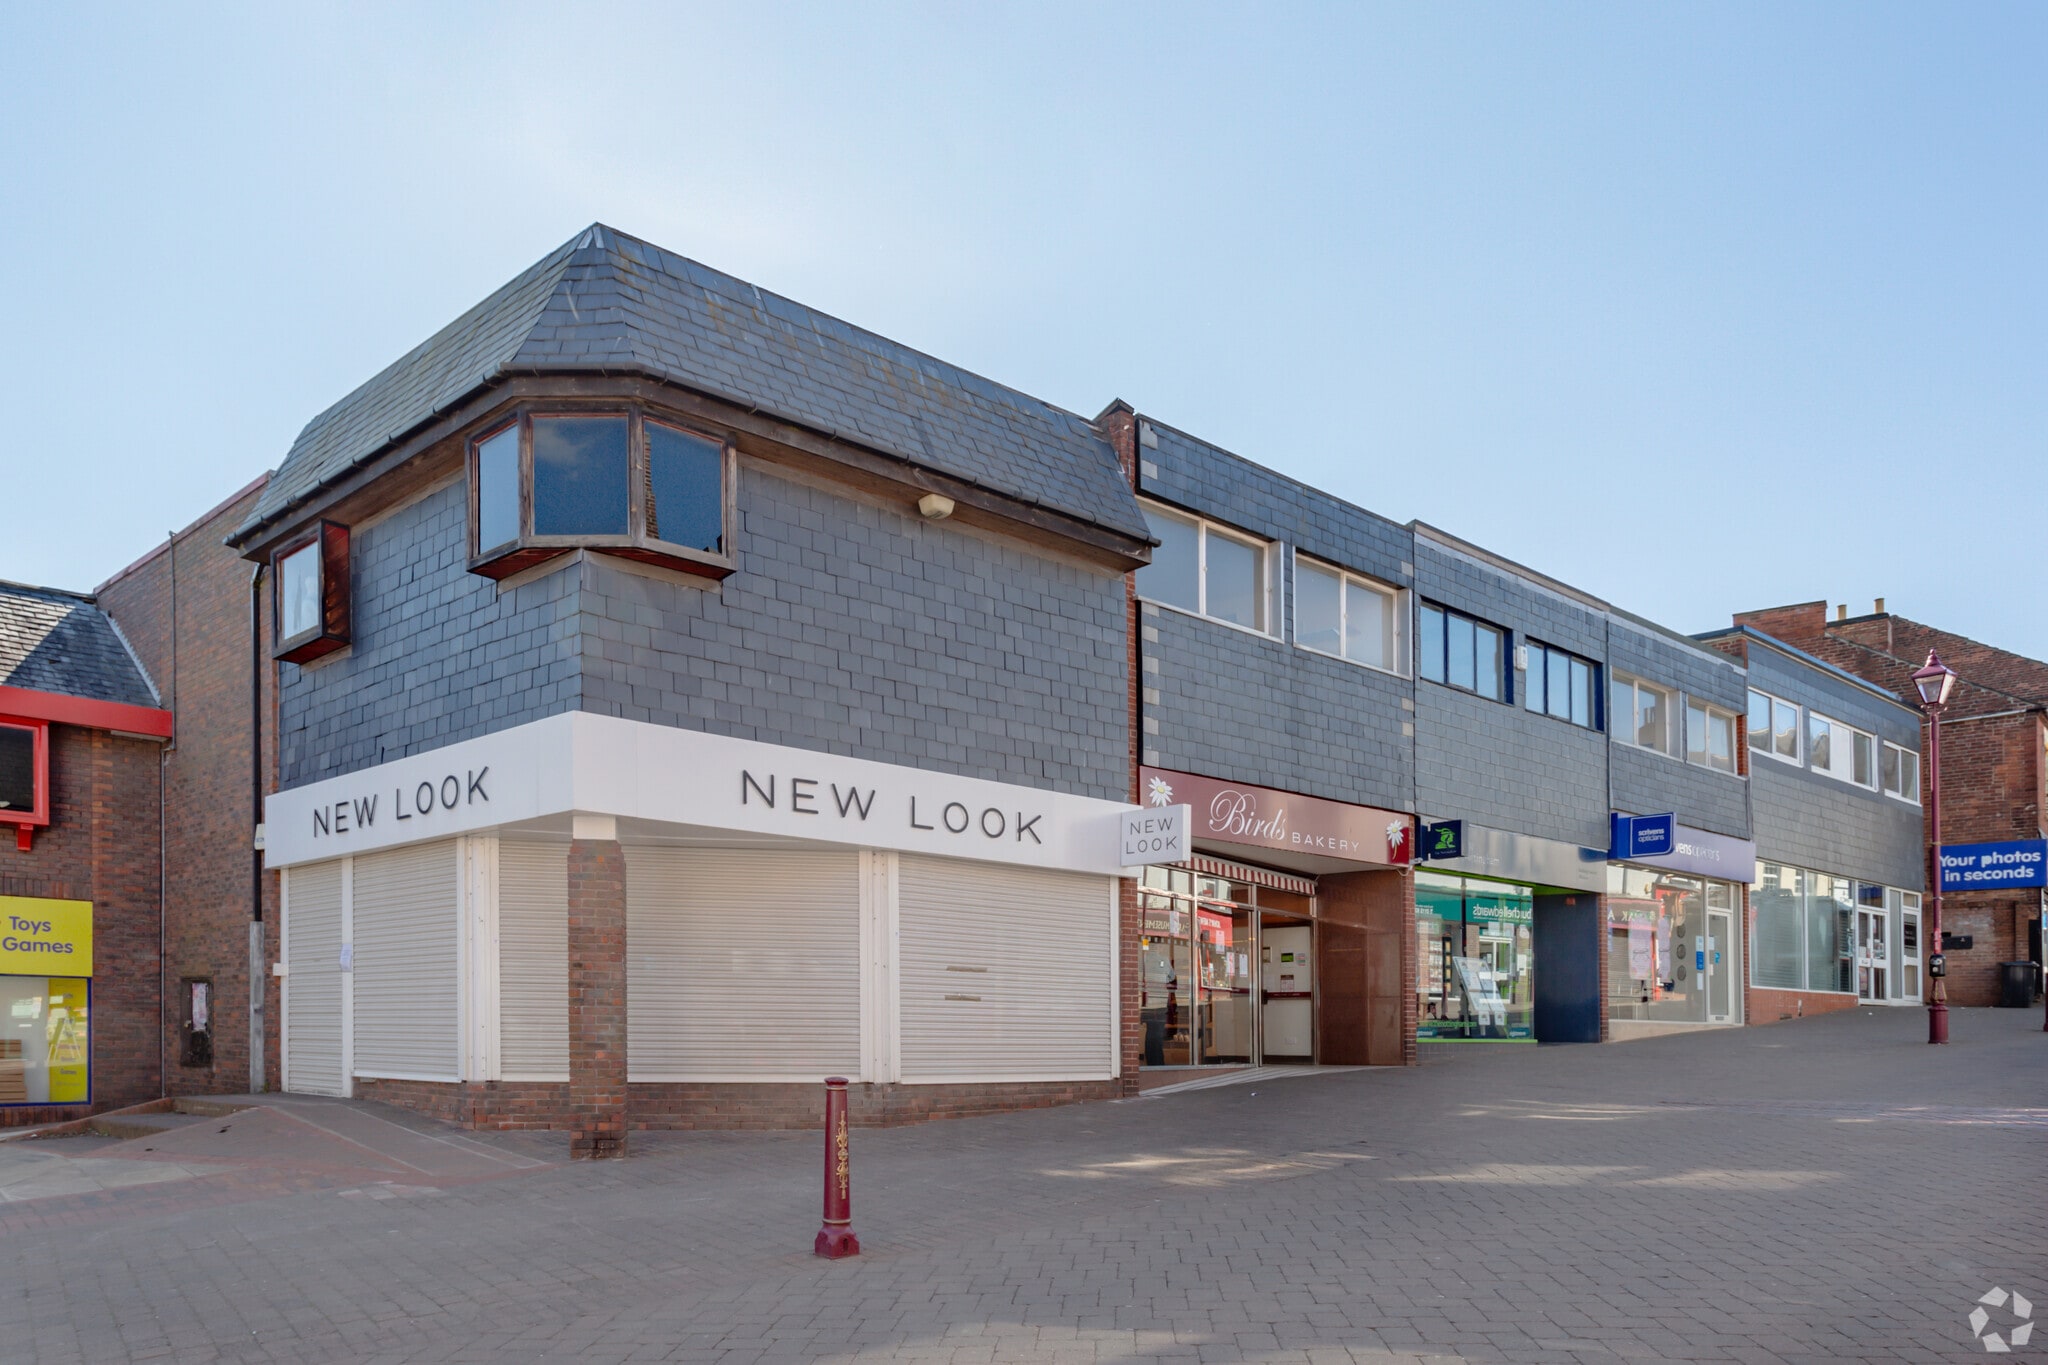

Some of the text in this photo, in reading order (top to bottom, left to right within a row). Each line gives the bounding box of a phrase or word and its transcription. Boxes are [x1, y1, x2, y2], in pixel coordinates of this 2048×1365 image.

[313, 766, 489, 837] NEW LOOK
[742, 769, 1042, 845] NEW LOOK
[1129, 816, 1174, 836] NEW
[1209, 789, 1361, 852] Birds BAKERY
[1638, 828, 1664, 836] scrivens
[1638, 835, 1664, 843] opticians
[1125, 836, 1178, 855] LOOK
[1940, 851, 2041, 868] Your photos
[1945, 865, 2035, 882] in seconds
[8, 916, 51, 935] Toys
[2, 936, 73, 954] Games
